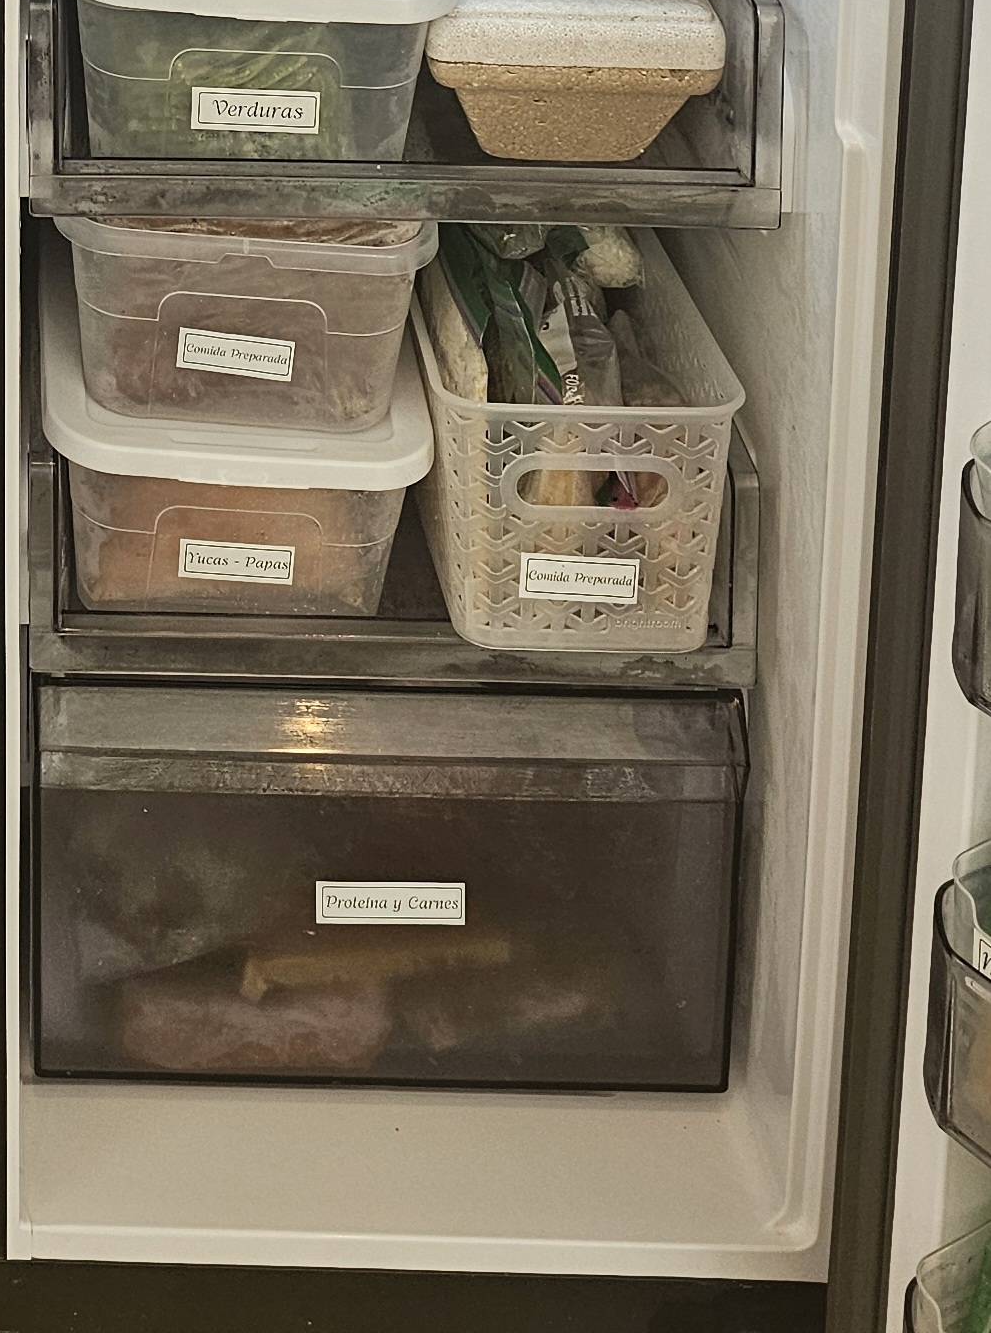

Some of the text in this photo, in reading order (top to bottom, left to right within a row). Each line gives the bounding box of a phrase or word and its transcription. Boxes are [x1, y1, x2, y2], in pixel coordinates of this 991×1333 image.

[212, 99, 304, 120] Verduras
[186, 342, 288, 365] Comida Preparada
[188, 551, 229, 566] Yucas
[244, 556, 290, 572] Papas
[528, 569, 633, 587] Comida Preparada
[392, 899, 402, 913] y
[408, 895, 459, 910] Carnes
